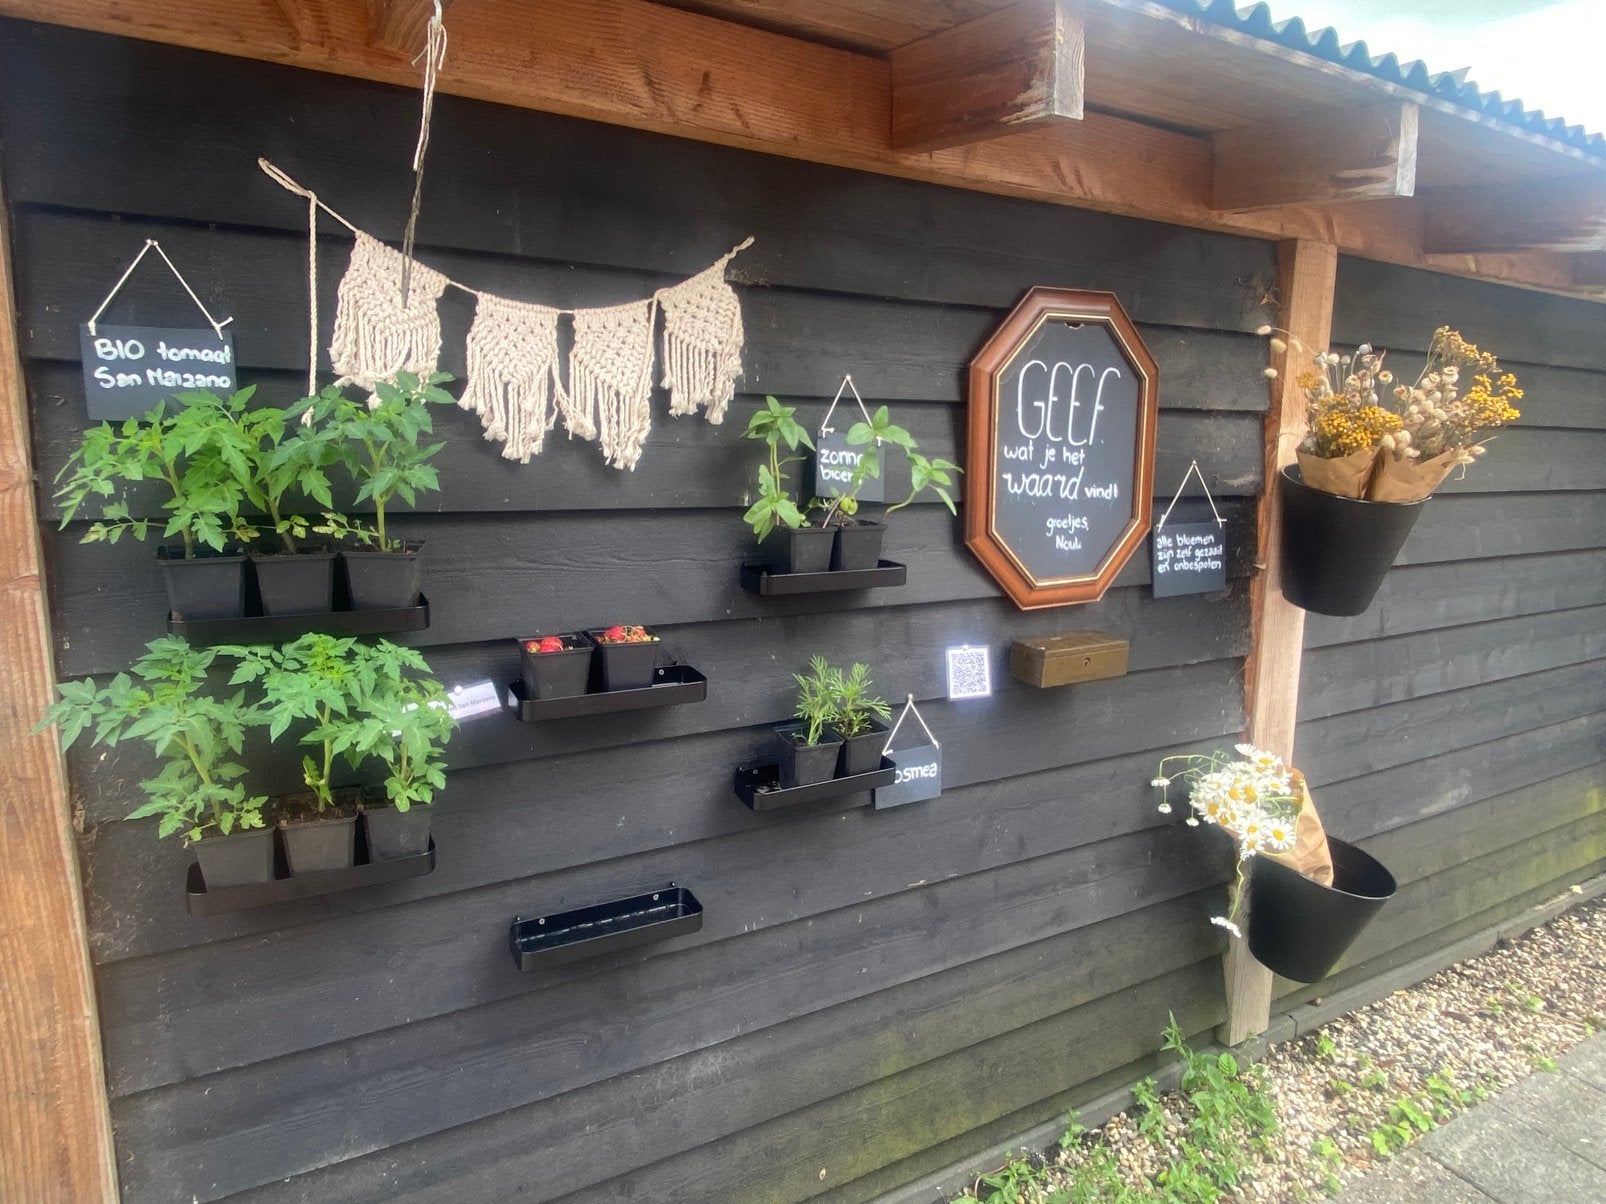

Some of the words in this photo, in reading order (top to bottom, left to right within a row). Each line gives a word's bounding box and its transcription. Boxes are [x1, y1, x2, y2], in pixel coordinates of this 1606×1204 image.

[94, 338, 145, 361] BIO
[157, 341, 231, 364] tomaat
[94, 366, 142, 389] San
[146, 367, 231, 388] Marzano
[1017, 359, 1121, 446] GEEF
[1004, 440, 1034, 462] wat
[1040, 443, 1056, 470] je
[1063, 447, 1085, 466] het
[1002, 466, 1084, 500] waard
[1085, 483, 1118, 499] vindt
[1157, 535, 1173, 549] alle
[1176, 533, 1214, 547] bloemen
[1176, 545, 1193, 559] zelf
[1157, 560, 1170, 573] en
[1173, 558, 1222, 573] onbespoten
[894, 762, 938, 784] osmea
